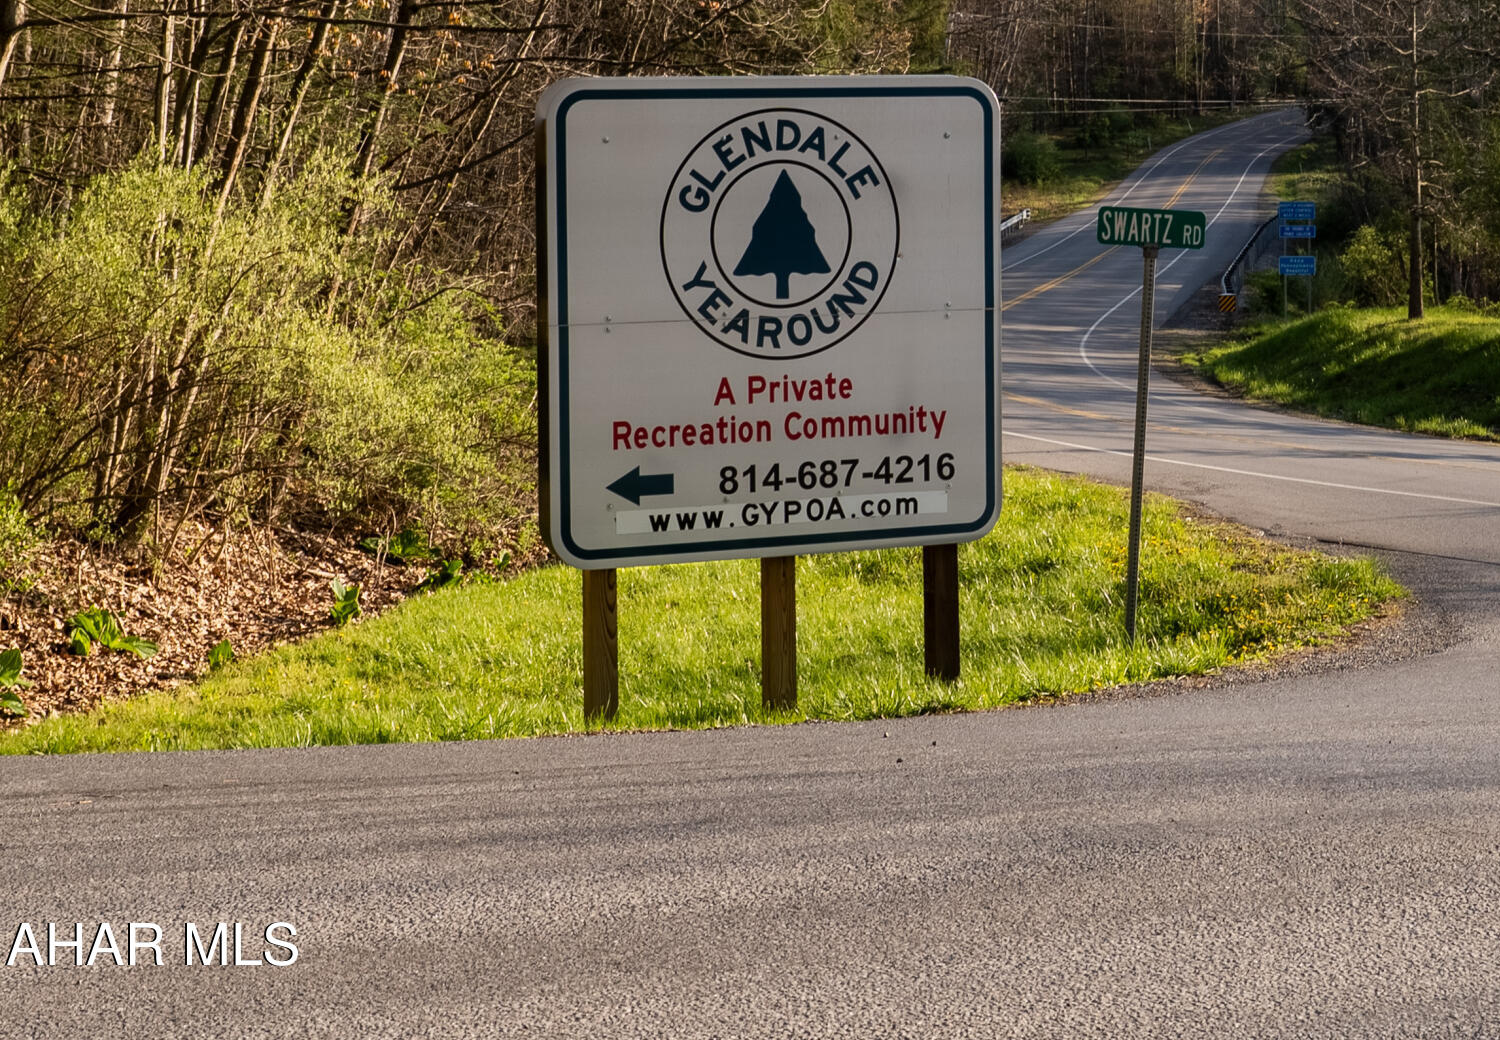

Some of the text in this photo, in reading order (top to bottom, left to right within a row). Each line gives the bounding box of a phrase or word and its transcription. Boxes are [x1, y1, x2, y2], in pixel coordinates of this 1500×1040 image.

[678, 119, 881, 214] GLENDALE
[1101, 210, 1201, 245] SWARTZ RD
[682, 260, 879, 349] YEAROUND
[713, 373, 853, 406] A Private
[612, 405, 947, 450] Recreation Community
[719, 453, 956, 495] 814-687-4216
[648, 494, 919, 532] www.GYPOA.com
